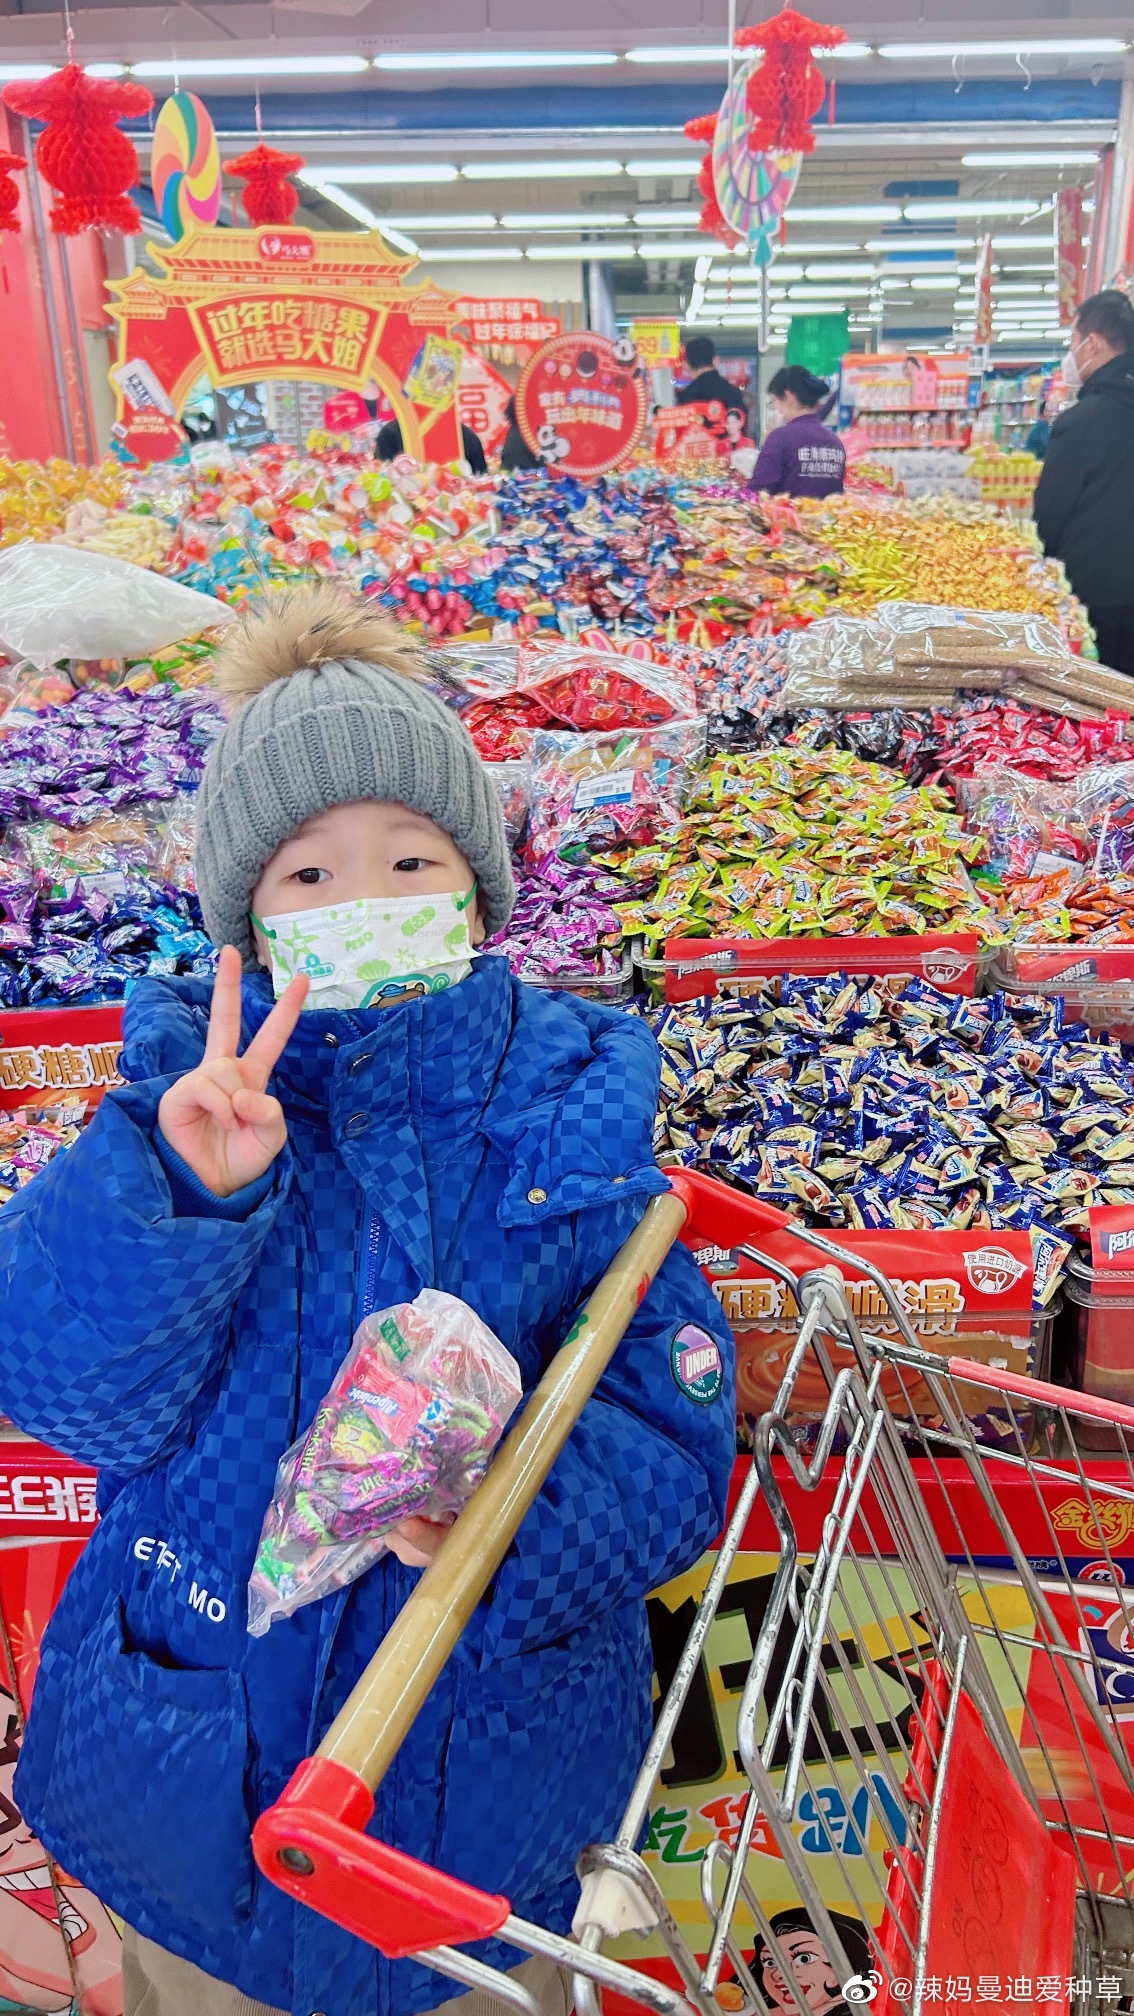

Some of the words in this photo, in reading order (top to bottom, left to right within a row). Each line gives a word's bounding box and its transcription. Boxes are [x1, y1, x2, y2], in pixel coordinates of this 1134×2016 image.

[206, 299, 370, 343] 过年吃糖果
[217, 328, 363, 371] 就选马大姐
[967, 1253, 1023, 1276] 使用进口奶源
[686, 1347, 718, 1379] UNDER
[188, 1581, 226, 1622] MO
